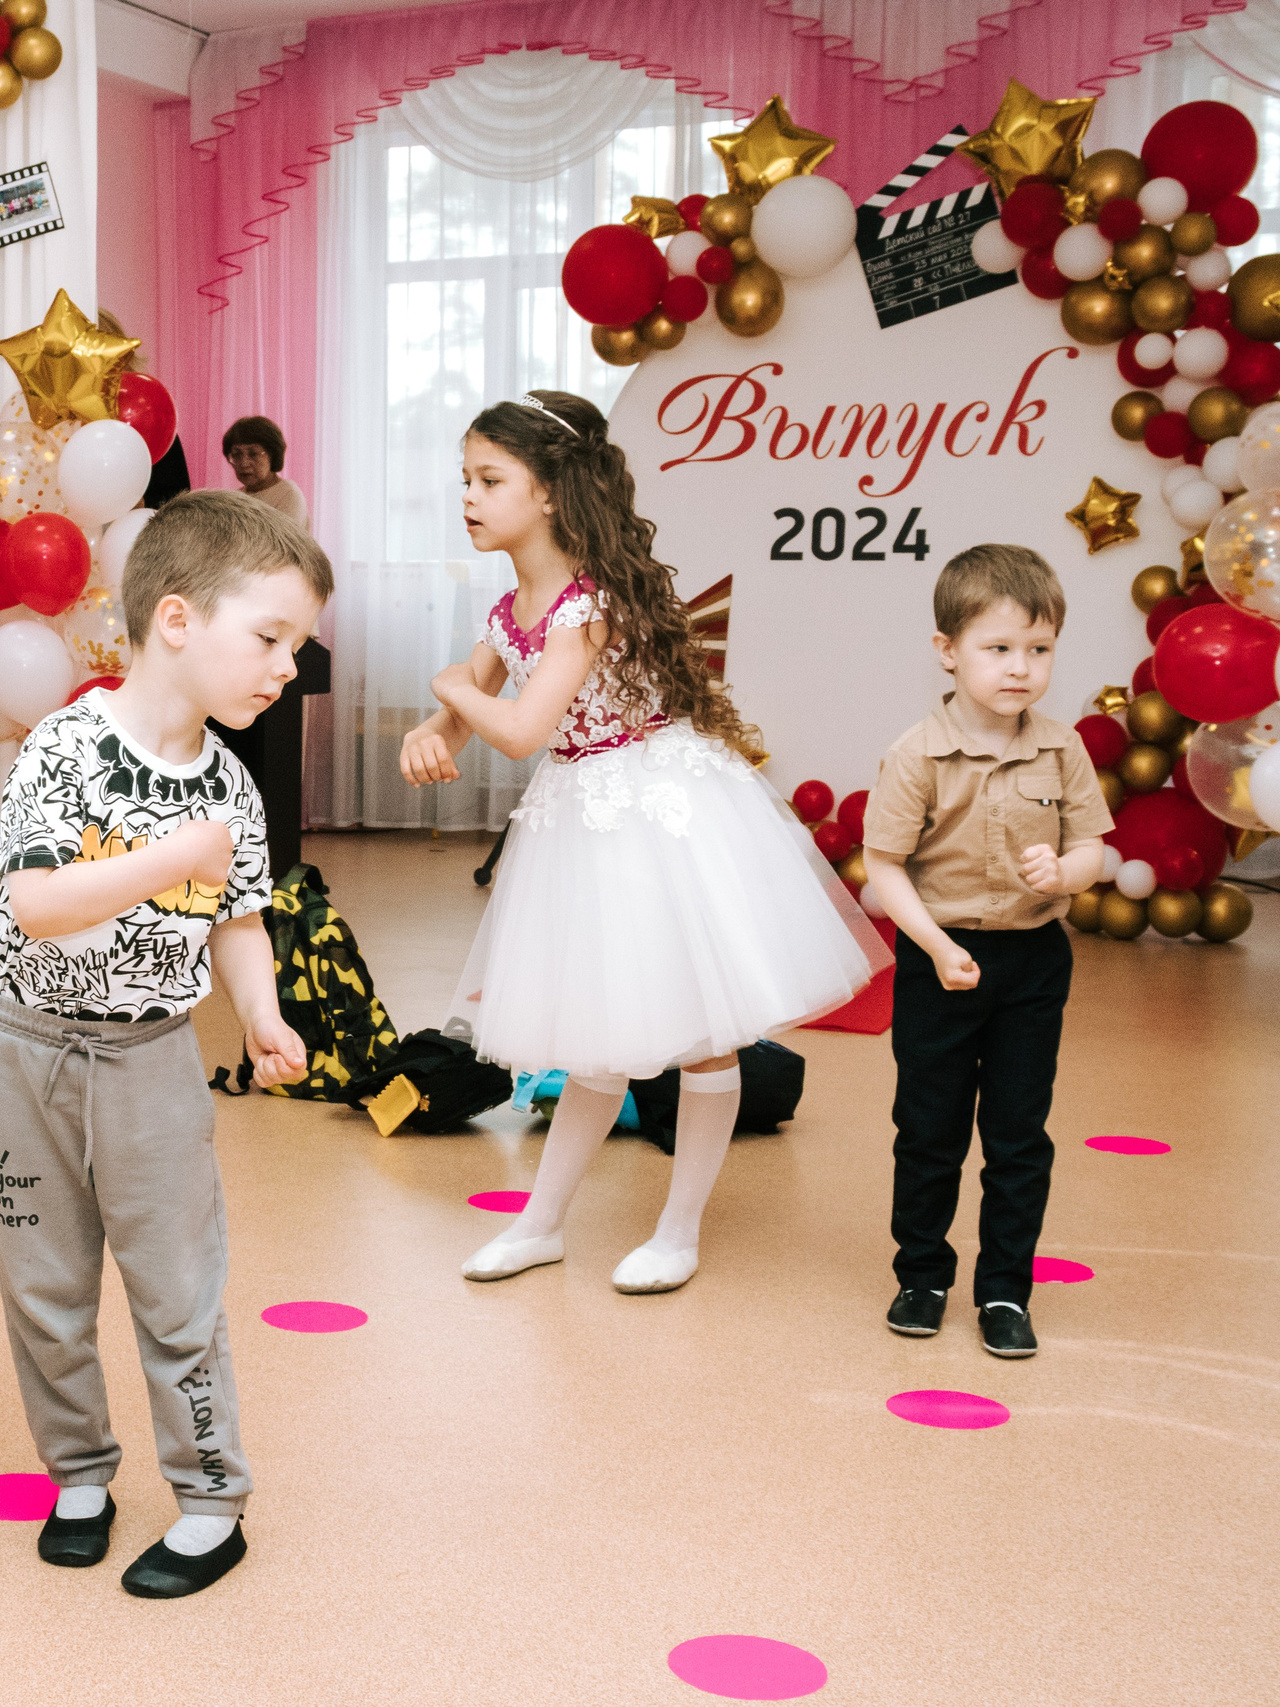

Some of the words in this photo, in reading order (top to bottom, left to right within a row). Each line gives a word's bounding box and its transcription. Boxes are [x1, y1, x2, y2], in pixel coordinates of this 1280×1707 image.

[885, 226, 925, 252] Детский
[927, 219, 943, 235] сад
[958, 211, 971, 225] 27
[950, 244, 971, 258] 202
[657, 346, 1079, 498] Выпуск
[770, 507, 930, 562] 2024
[197, 1448, 229, 1493] WHY
